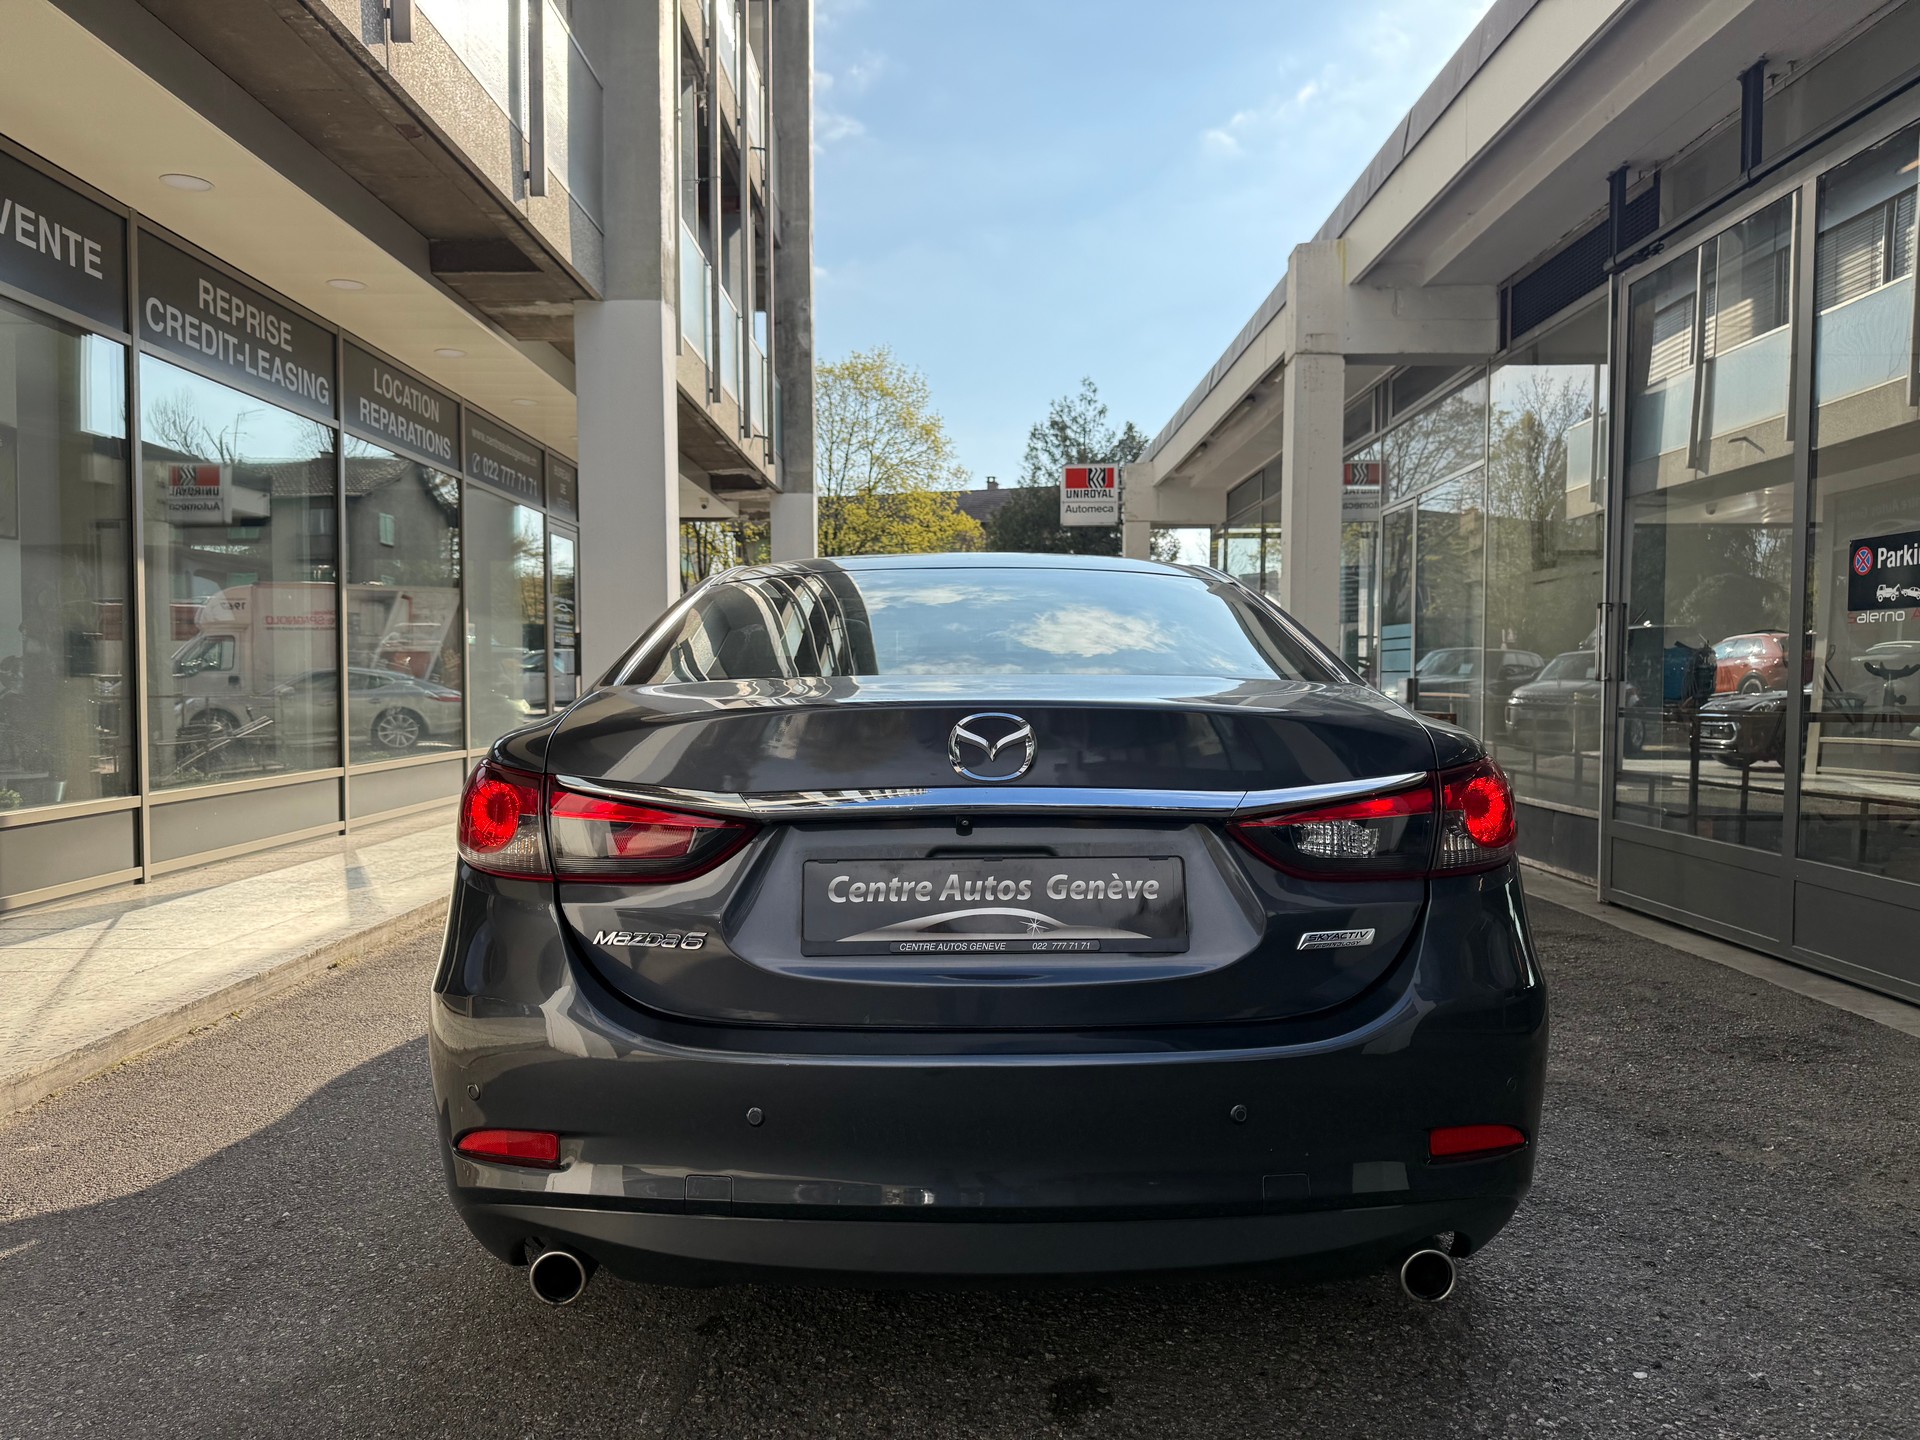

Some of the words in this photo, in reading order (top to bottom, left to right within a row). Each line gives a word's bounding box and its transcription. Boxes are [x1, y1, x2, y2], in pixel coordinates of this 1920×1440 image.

[199, 278, 293, 352] REPRISE
[145, 297, 329, 405] CREDIT-LEASING
[374, 368, 439, 423] LOCATION
[360, 397, 451, 459] REPARATIONS
[483, 457, 499, 480] 022
[501, 465, 516, 488] 777
[517, 473, 527, 493] 71
[528, 477, 538, 496] 71
[1065, 505, 1114, 513] Automeca
[1066, 490, 1114, 499] UNIROYAL
[1877, 543, 1920, 569] Parki
[827, 875, 932, 903] Centre
[939, 873, 1032, 901] Autos
[1045, 872, 1160, 901] Genève
[900, 942, 936, 951] CENTRE
[937, 942, 968, 951] AUTOS
[969, 942, 1006, 950] GENEVE
[1032, 942, 1048, 950] 022
[1052, 942, 1067, 950] 777
[1068, 942, 1079, 950] 71
[1081, 942, 1091, 950] 71
[1308, 930, 1369, 942] SKYACTIV
